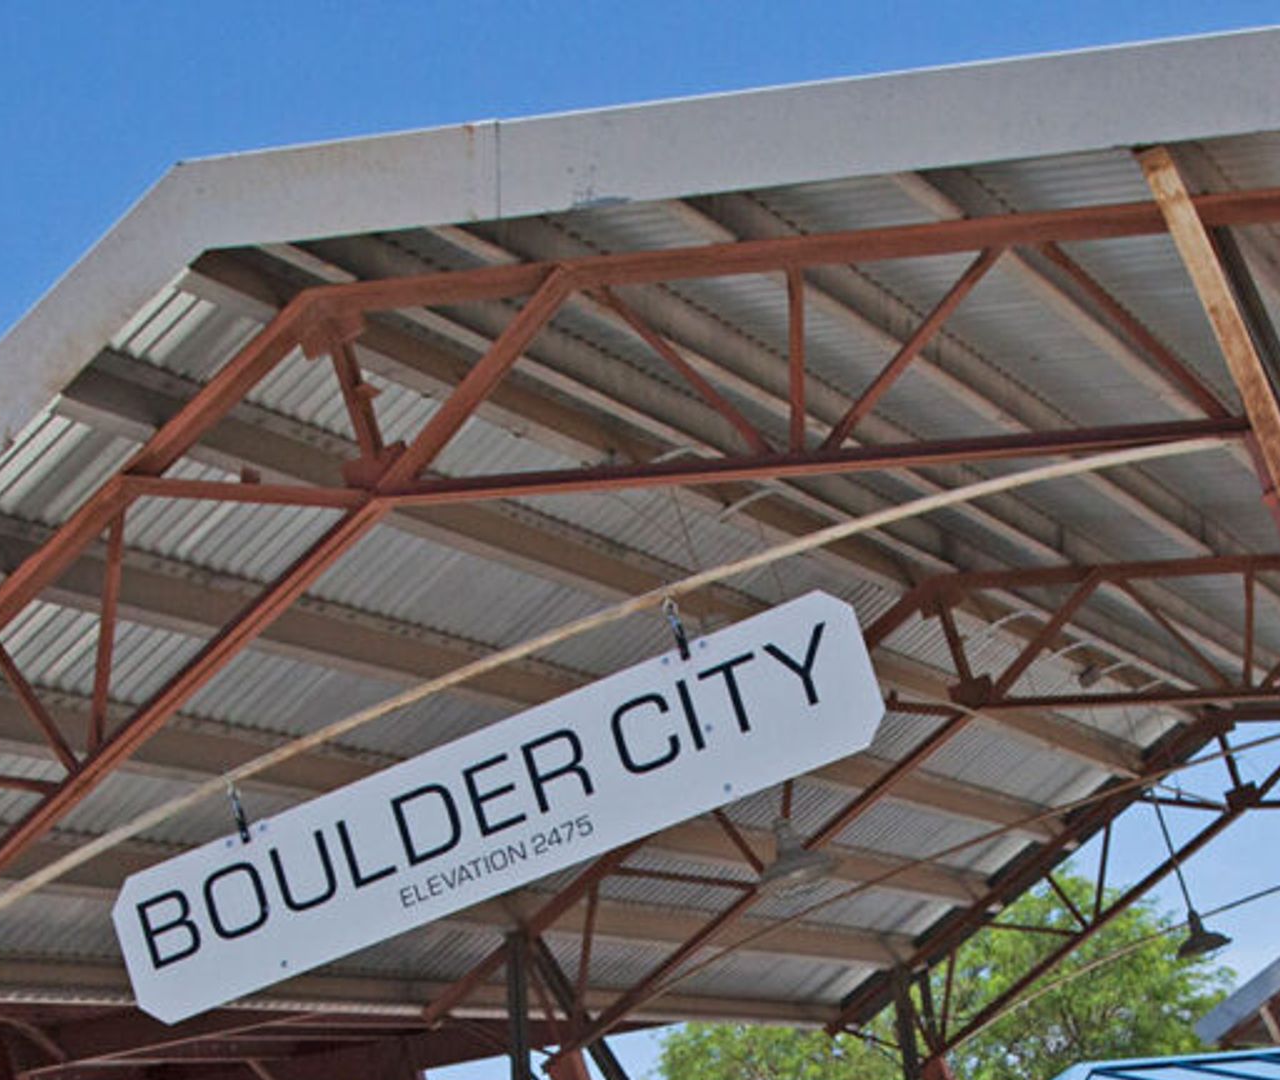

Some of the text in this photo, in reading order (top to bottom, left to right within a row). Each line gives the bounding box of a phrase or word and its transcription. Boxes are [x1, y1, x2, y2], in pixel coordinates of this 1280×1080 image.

[135, 622, 827, 971] BOULDER CITY
[399, 813, 595, 909] ELEVATION 2475
